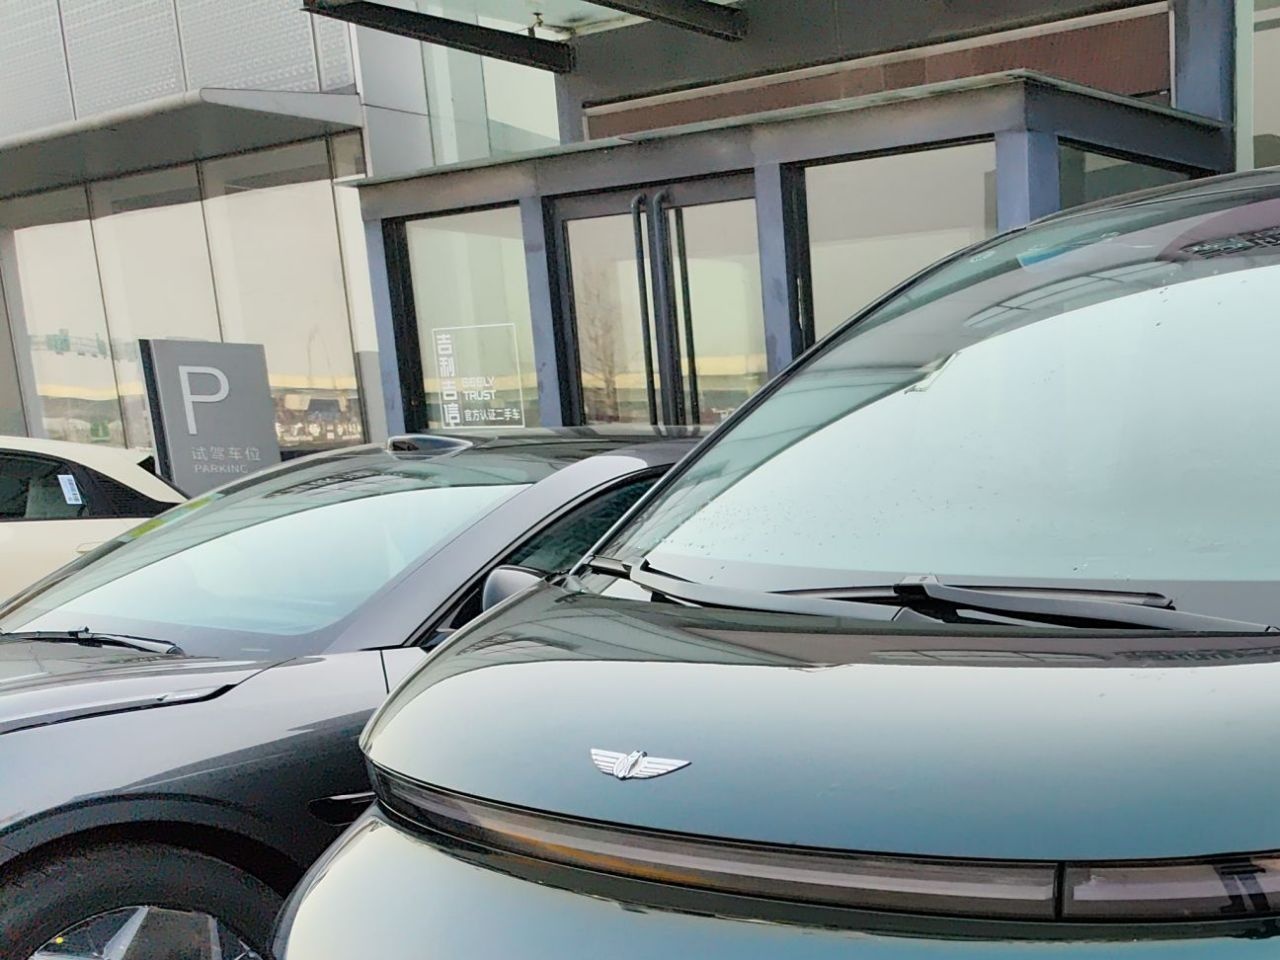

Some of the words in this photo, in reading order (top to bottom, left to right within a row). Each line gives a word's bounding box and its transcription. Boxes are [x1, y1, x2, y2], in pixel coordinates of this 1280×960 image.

[436, 333, 460, 424] 吉利吉信
[178, 365, 230, 435] P
[463, 390, 496, 401] TRUST
[463, 408, 520, 421] 官方认证二手车
[191, 446, 261, 461] 试驾车位
